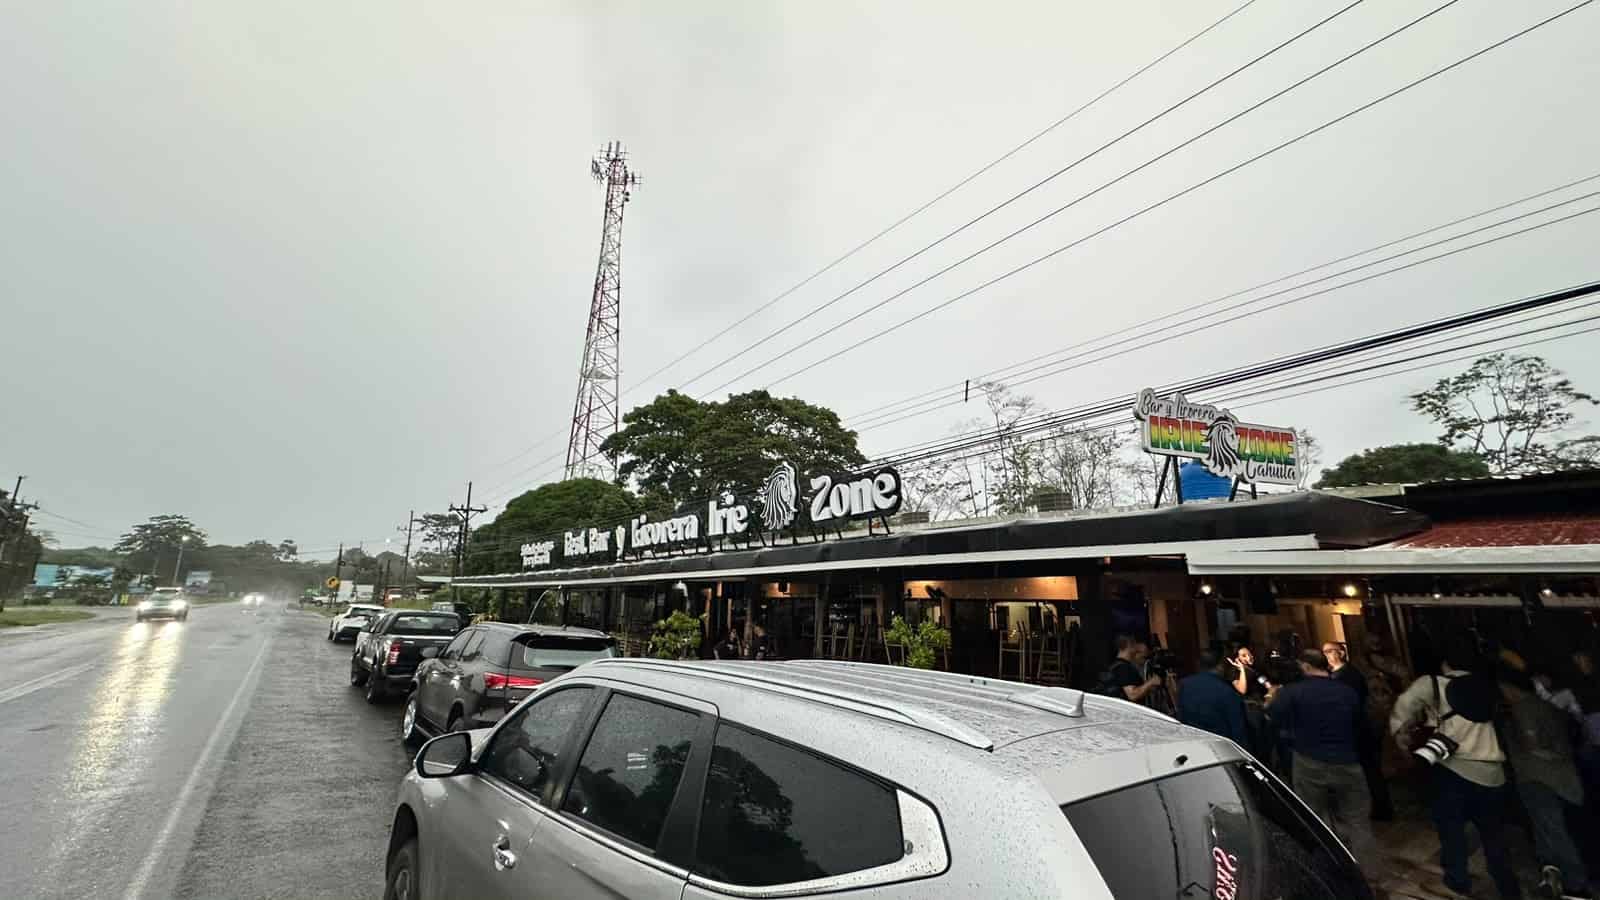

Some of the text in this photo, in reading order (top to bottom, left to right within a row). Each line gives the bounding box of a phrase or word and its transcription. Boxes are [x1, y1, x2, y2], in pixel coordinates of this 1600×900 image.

[1140, 392, 1163, 416] Bar
[1149, 415, 1296, 466] IRIE ZONE
[1245, 456, 1297, 481] Cahuita
[588, 527, 611, 553] Bar
[615, 524, 626, 562] y
[631, 513, 699, 548] Licorera
[707, 494, 749, 537] Irie
[810, 472, 899, 522] Zone
